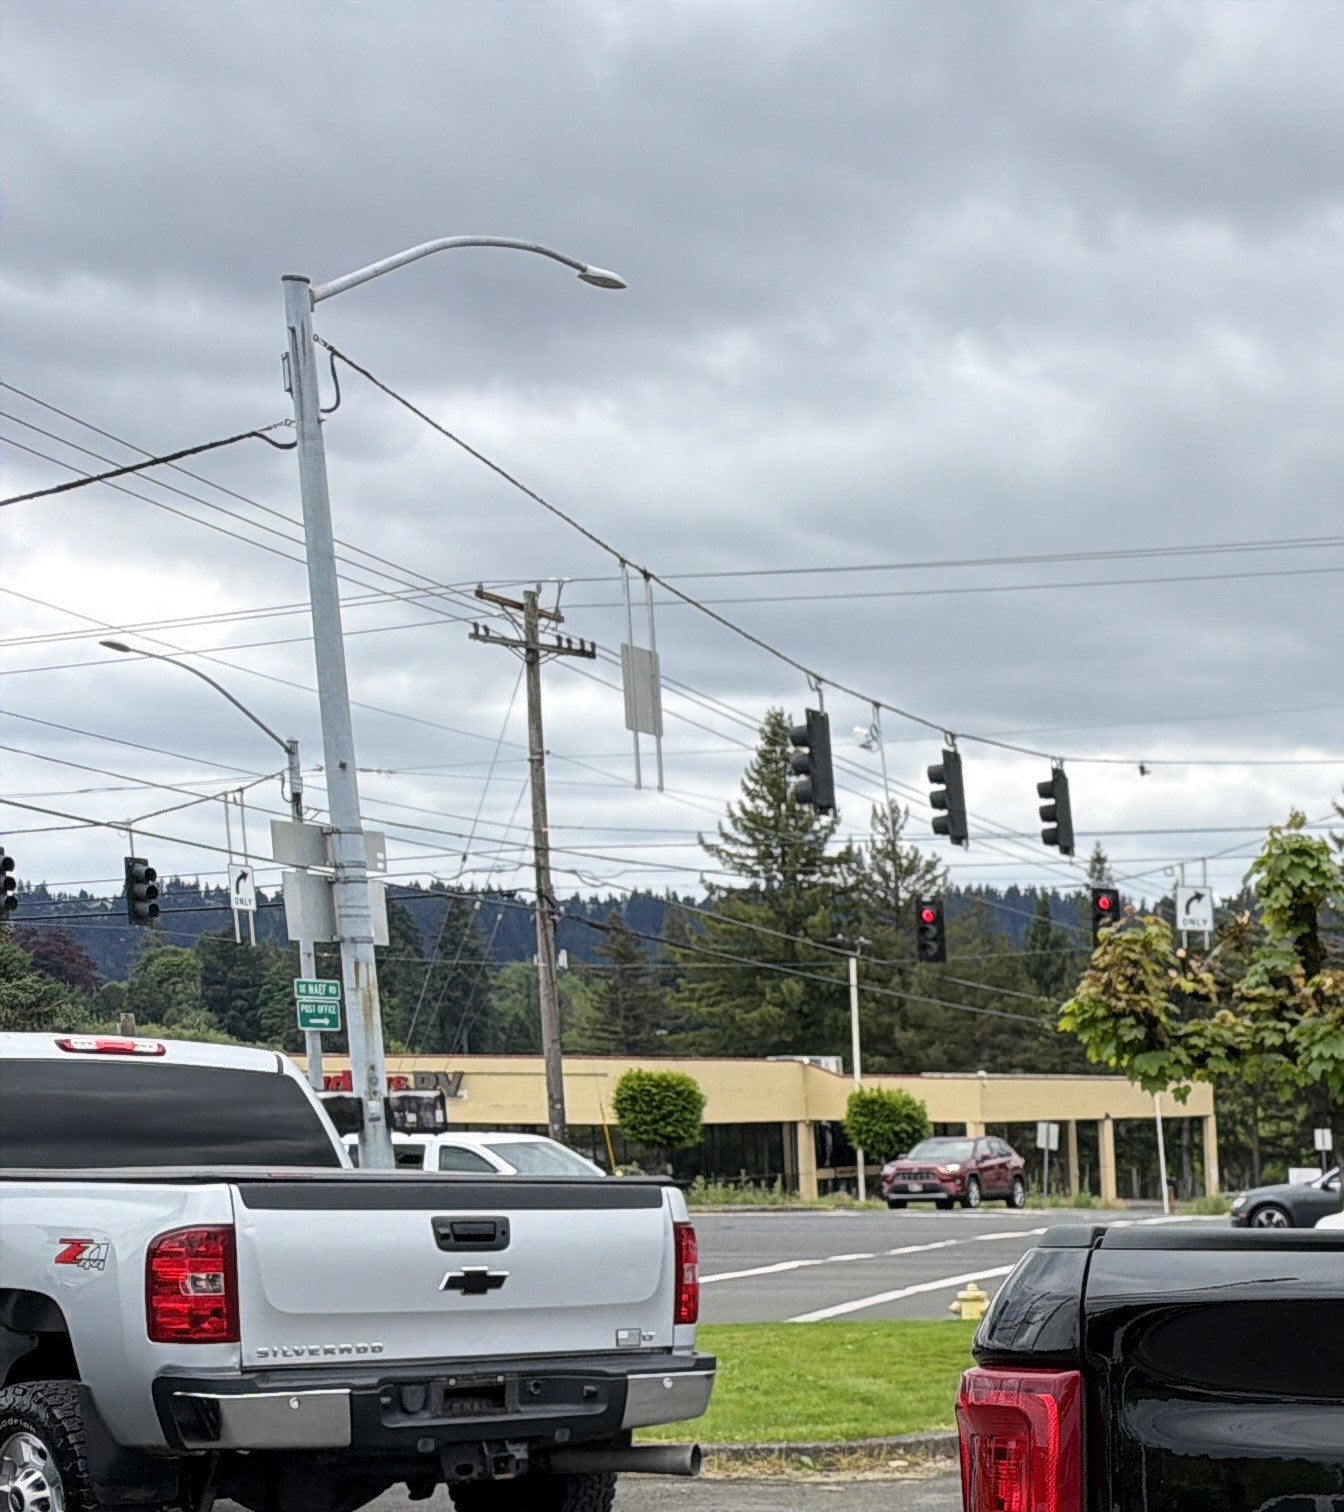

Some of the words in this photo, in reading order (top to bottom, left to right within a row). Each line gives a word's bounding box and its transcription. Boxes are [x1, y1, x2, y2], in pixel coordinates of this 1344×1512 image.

[234, 896, 253, 906] ONLY
[300, 1004, 316, 1014] POST
[317, 1004, 337, 1014] OFFICE
[413, 1071, 465, 1097] RV
[256, 1342, 383, 1359] SILVERADO
